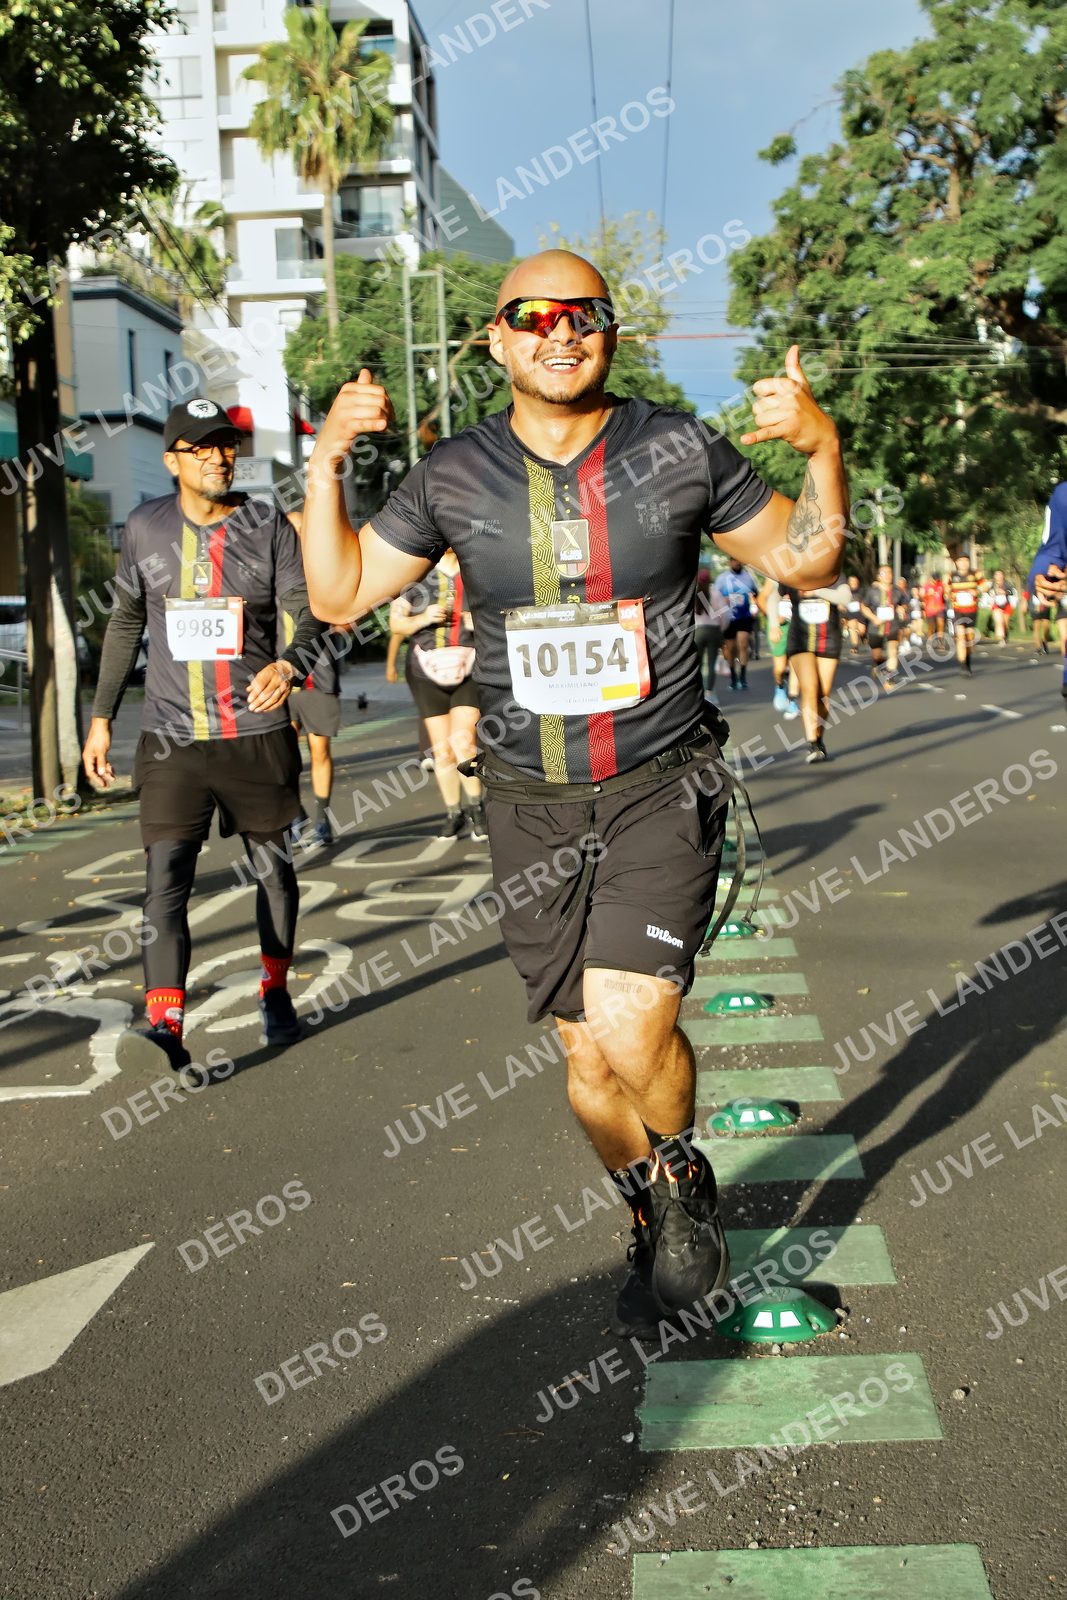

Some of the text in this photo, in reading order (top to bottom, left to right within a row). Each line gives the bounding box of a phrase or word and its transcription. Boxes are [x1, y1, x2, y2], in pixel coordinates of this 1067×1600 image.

[176, 618, 225, 638] 9985
[516, 637, 629, 678] 10154
[548, 681, 599, 689] MAXIMILIANO
[646, 924, 684, 949] Wilson
